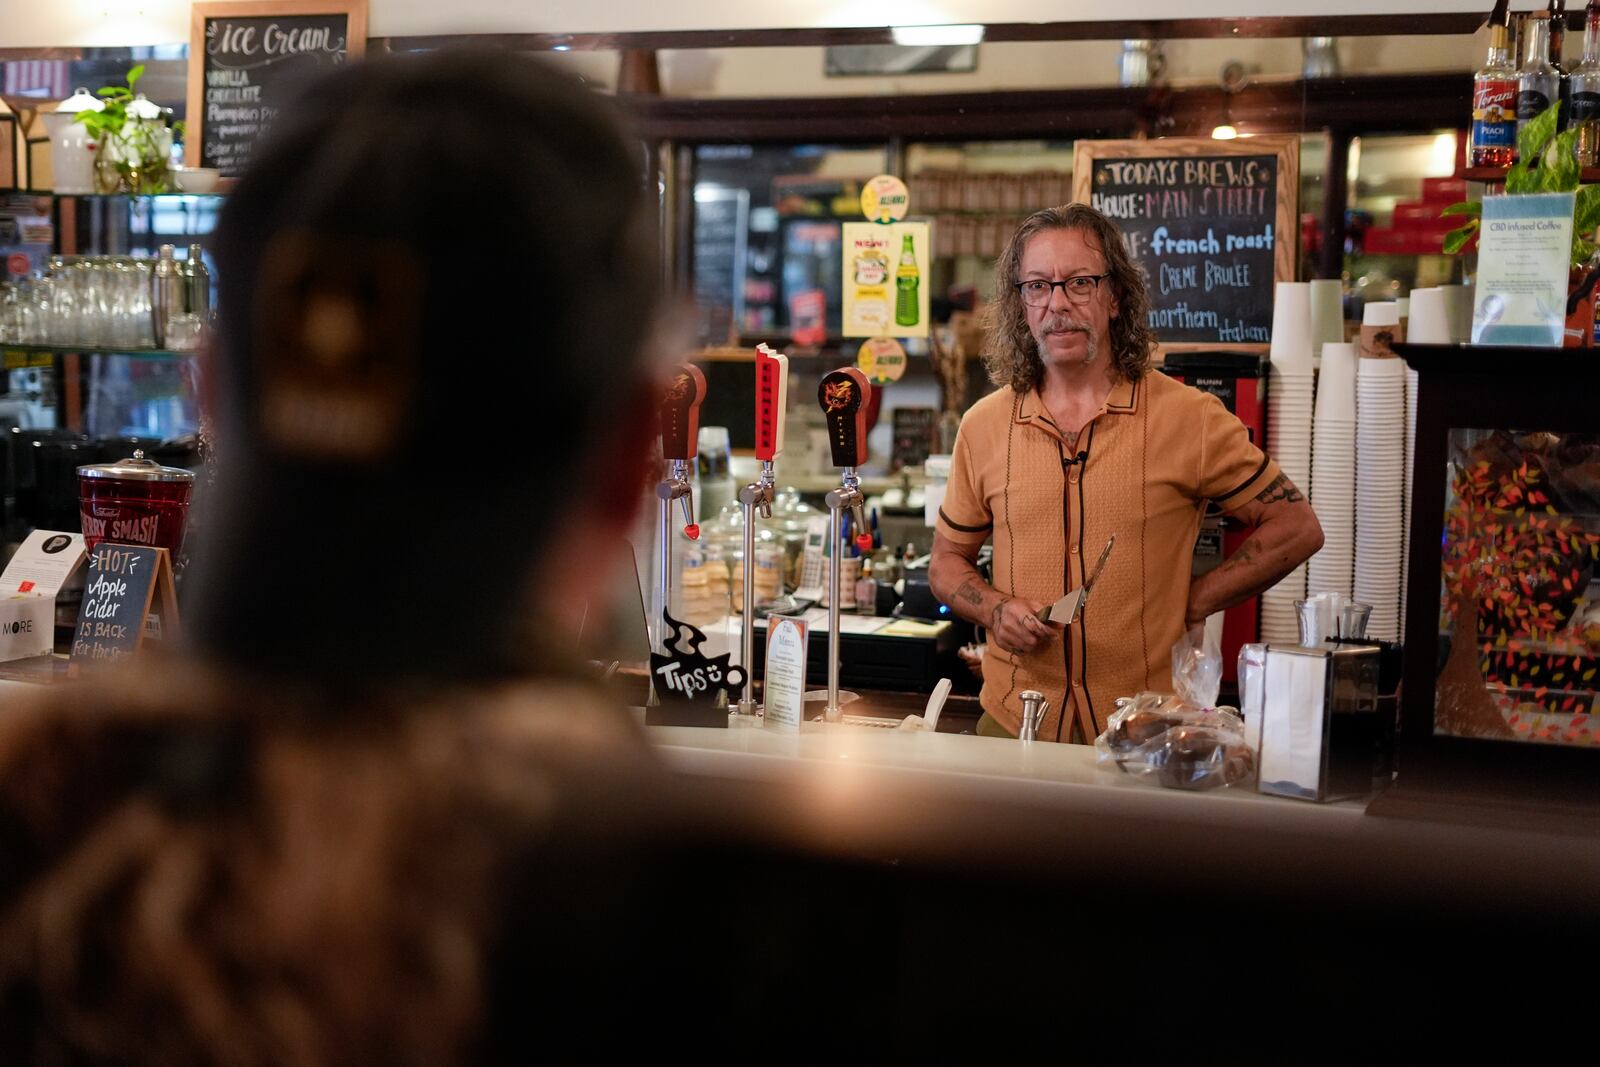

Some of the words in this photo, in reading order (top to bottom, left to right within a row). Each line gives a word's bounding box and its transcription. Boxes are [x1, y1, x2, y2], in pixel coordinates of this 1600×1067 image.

[263, 23, 344, 55] Cream
[1476, 87, 1514, 109] Torani
[1481, 126, 1505, 136] PEACH
[1184, 160, 1260, 187] BREWS
[1145, 189, 1194, 218] MAIN
[1200, 187, 1267, 217] STREET
[1151, 226, 1221, 256] french
[1226, 224, 1274, 252] roast
[1490, 223, 1507, 232] CBD
[1507, 222, 1536, 232] infused
[1536, 221, 1562, 231] Coffee
[1159, 262, 1198, 296] CREME
[1204, 259, 1251, 293] BRULEE
[1148, 302, 1218, 328] northern
[111, 514, 159, 545] SMASH
[97, 549, 134, 574] HOT
[88, 574, 127, 602] Apple
[85, 600, 120, 619] Cider
[80, 622, 92, 637] IS
[94, 622, 127, 639] BACK
[656, 661, 708, 700] Tips
